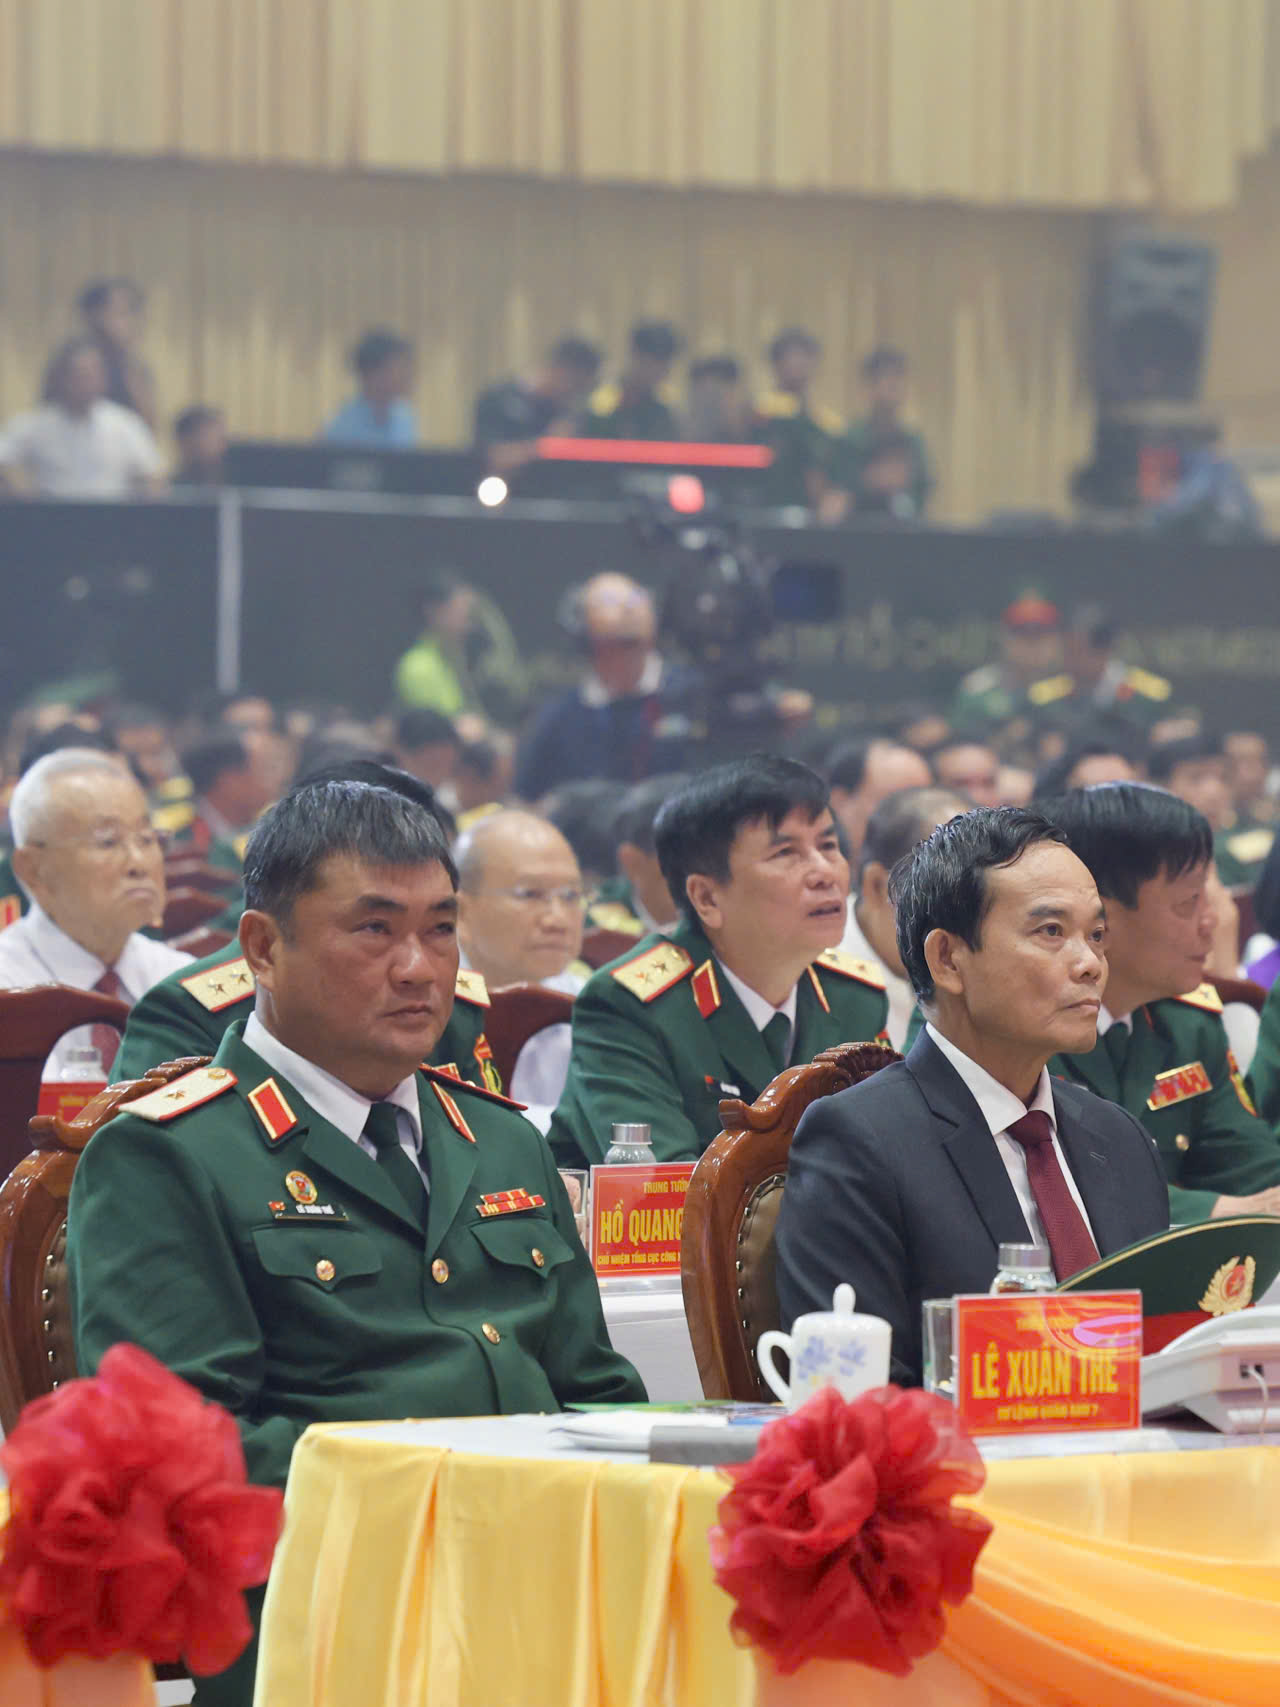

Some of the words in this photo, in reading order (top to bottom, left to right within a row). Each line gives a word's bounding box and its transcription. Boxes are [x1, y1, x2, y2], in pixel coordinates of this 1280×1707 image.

[600, 1199, 624, 1244] HỒ
[971, 1340, 1000, 1399] LÊ
[1006, 1341, 1072, 1398] XUÂN
